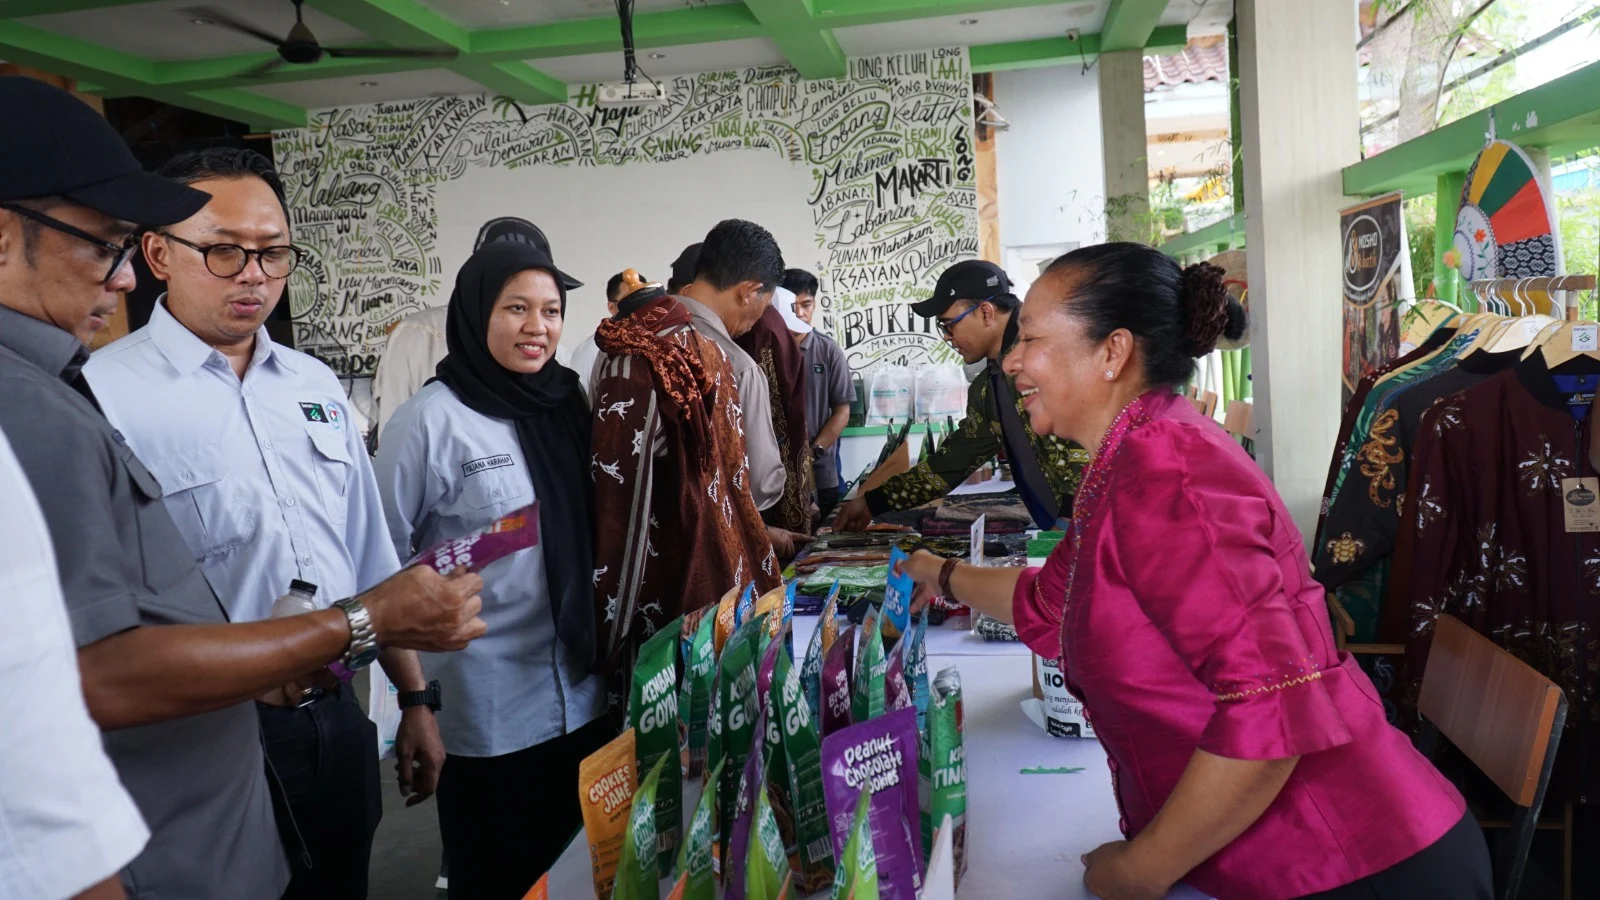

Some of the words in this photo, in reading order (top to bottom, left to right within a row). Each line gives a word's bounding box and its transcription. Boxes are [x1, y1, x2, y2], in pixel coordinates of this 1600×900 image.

[850, 56, 882, 80] LONG
[887, 53, 928, 75] KELUH
[932, 48, 961, 59] LONG
[697, 70, 738, 85] GIRING
[804, 80, 834, 95] LONG
[890, 80, 921, 101] LONG
[682, 107, 706, 133] EKA
[707, 95, 743, 120] SAPTA
[747, 84, 797, 113] CAMPUR
[315, 108, 377, 148] Kasai
[376, 123, 413, 133] TEPIAN
[422, 92, 487, 167] KARANGAN
[546, 106, 593, 158] HARAPAN
[817, 109, 840, 132] LONG
[875, 158, 951, 209] MAKARTI
[871, 336, 925, 351] MAKMUR
[641, 663, 677, 706] KEMBAN
[844, 733, 899, 766] Peanut
[588, 764, 632, 804] COOKIES
[845, 750, 903, 787] Chocolate
[603, 782, 633, 814] JAHE
